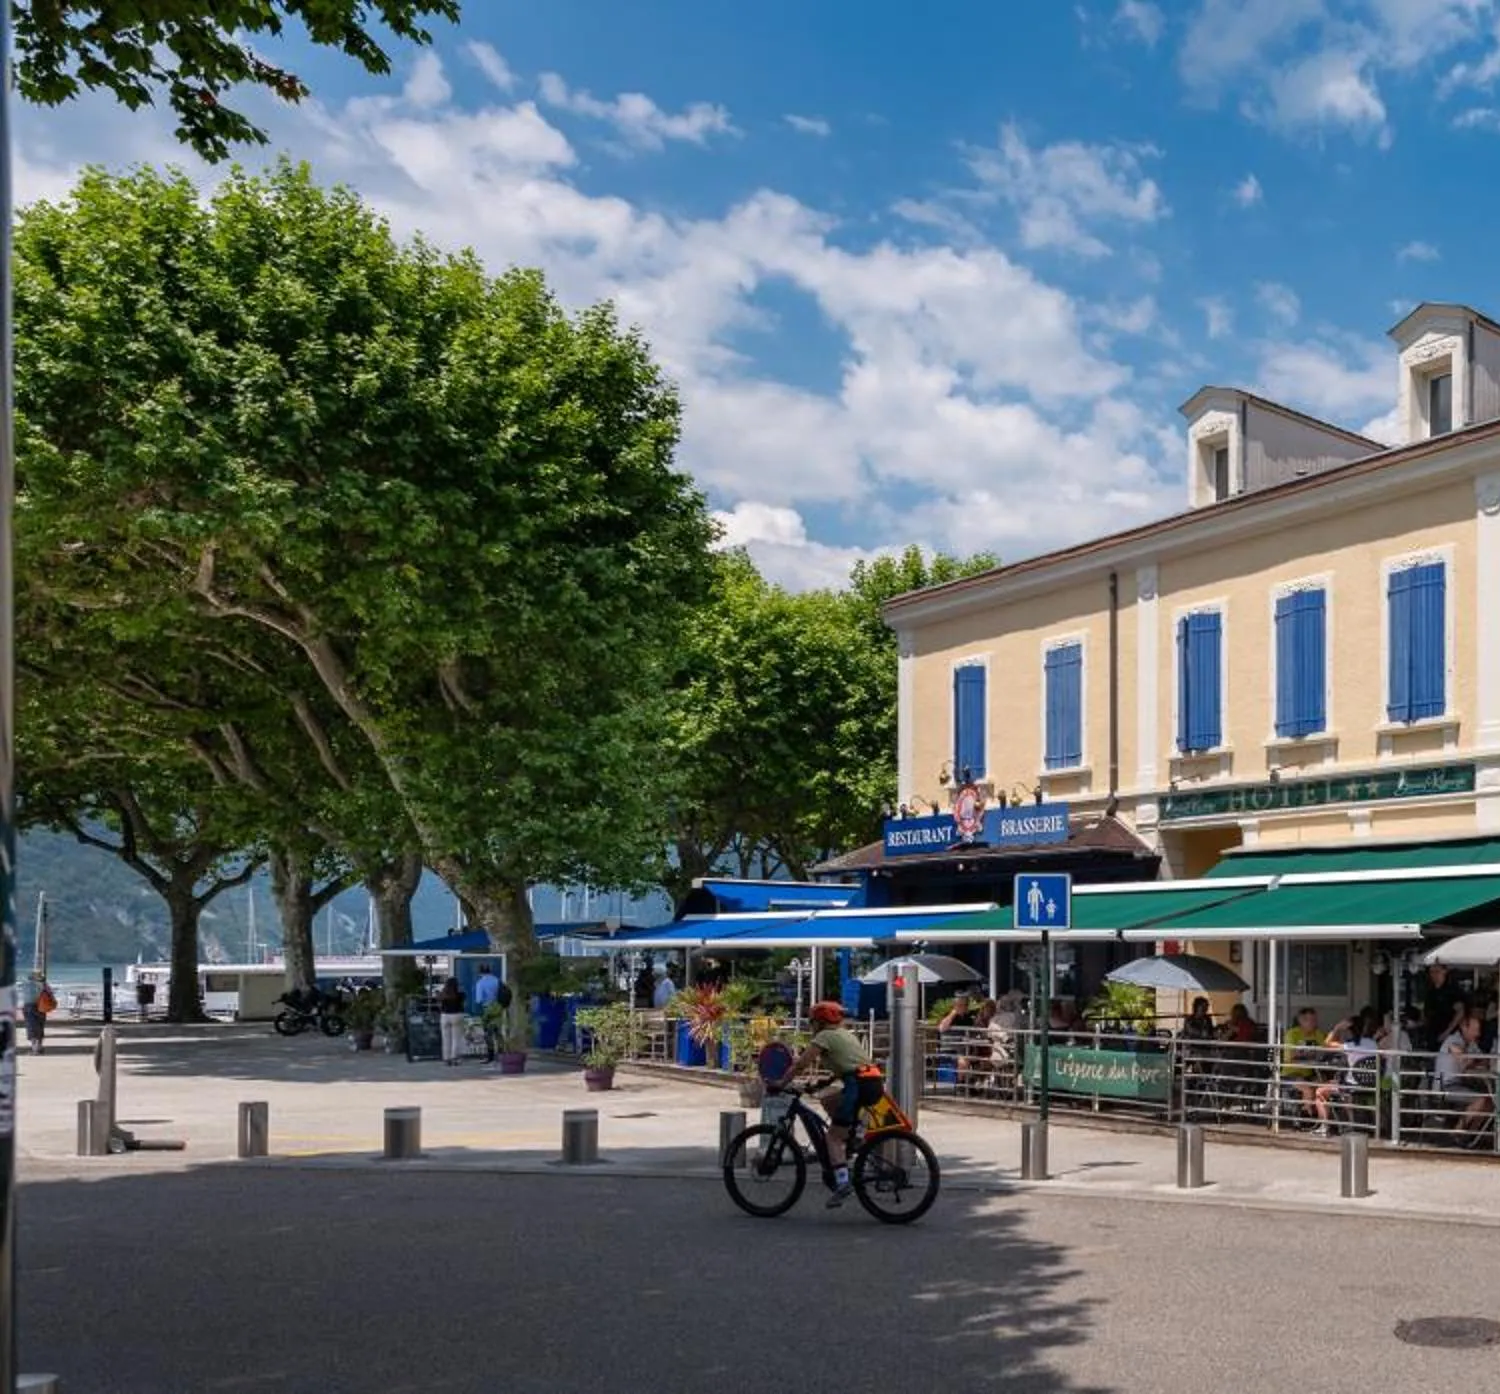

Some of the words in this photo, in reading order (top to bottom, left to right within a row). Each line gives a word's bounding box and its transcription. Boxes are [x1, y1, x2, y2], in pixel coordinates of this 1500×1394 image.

[887, 825, 953, 847] RESTAURANT
[1001, 815, 1065, 837] BRASSERIE
[1108, 1058, 1128, 1080] du
[1131, 1059, 1166, 1084] Port
